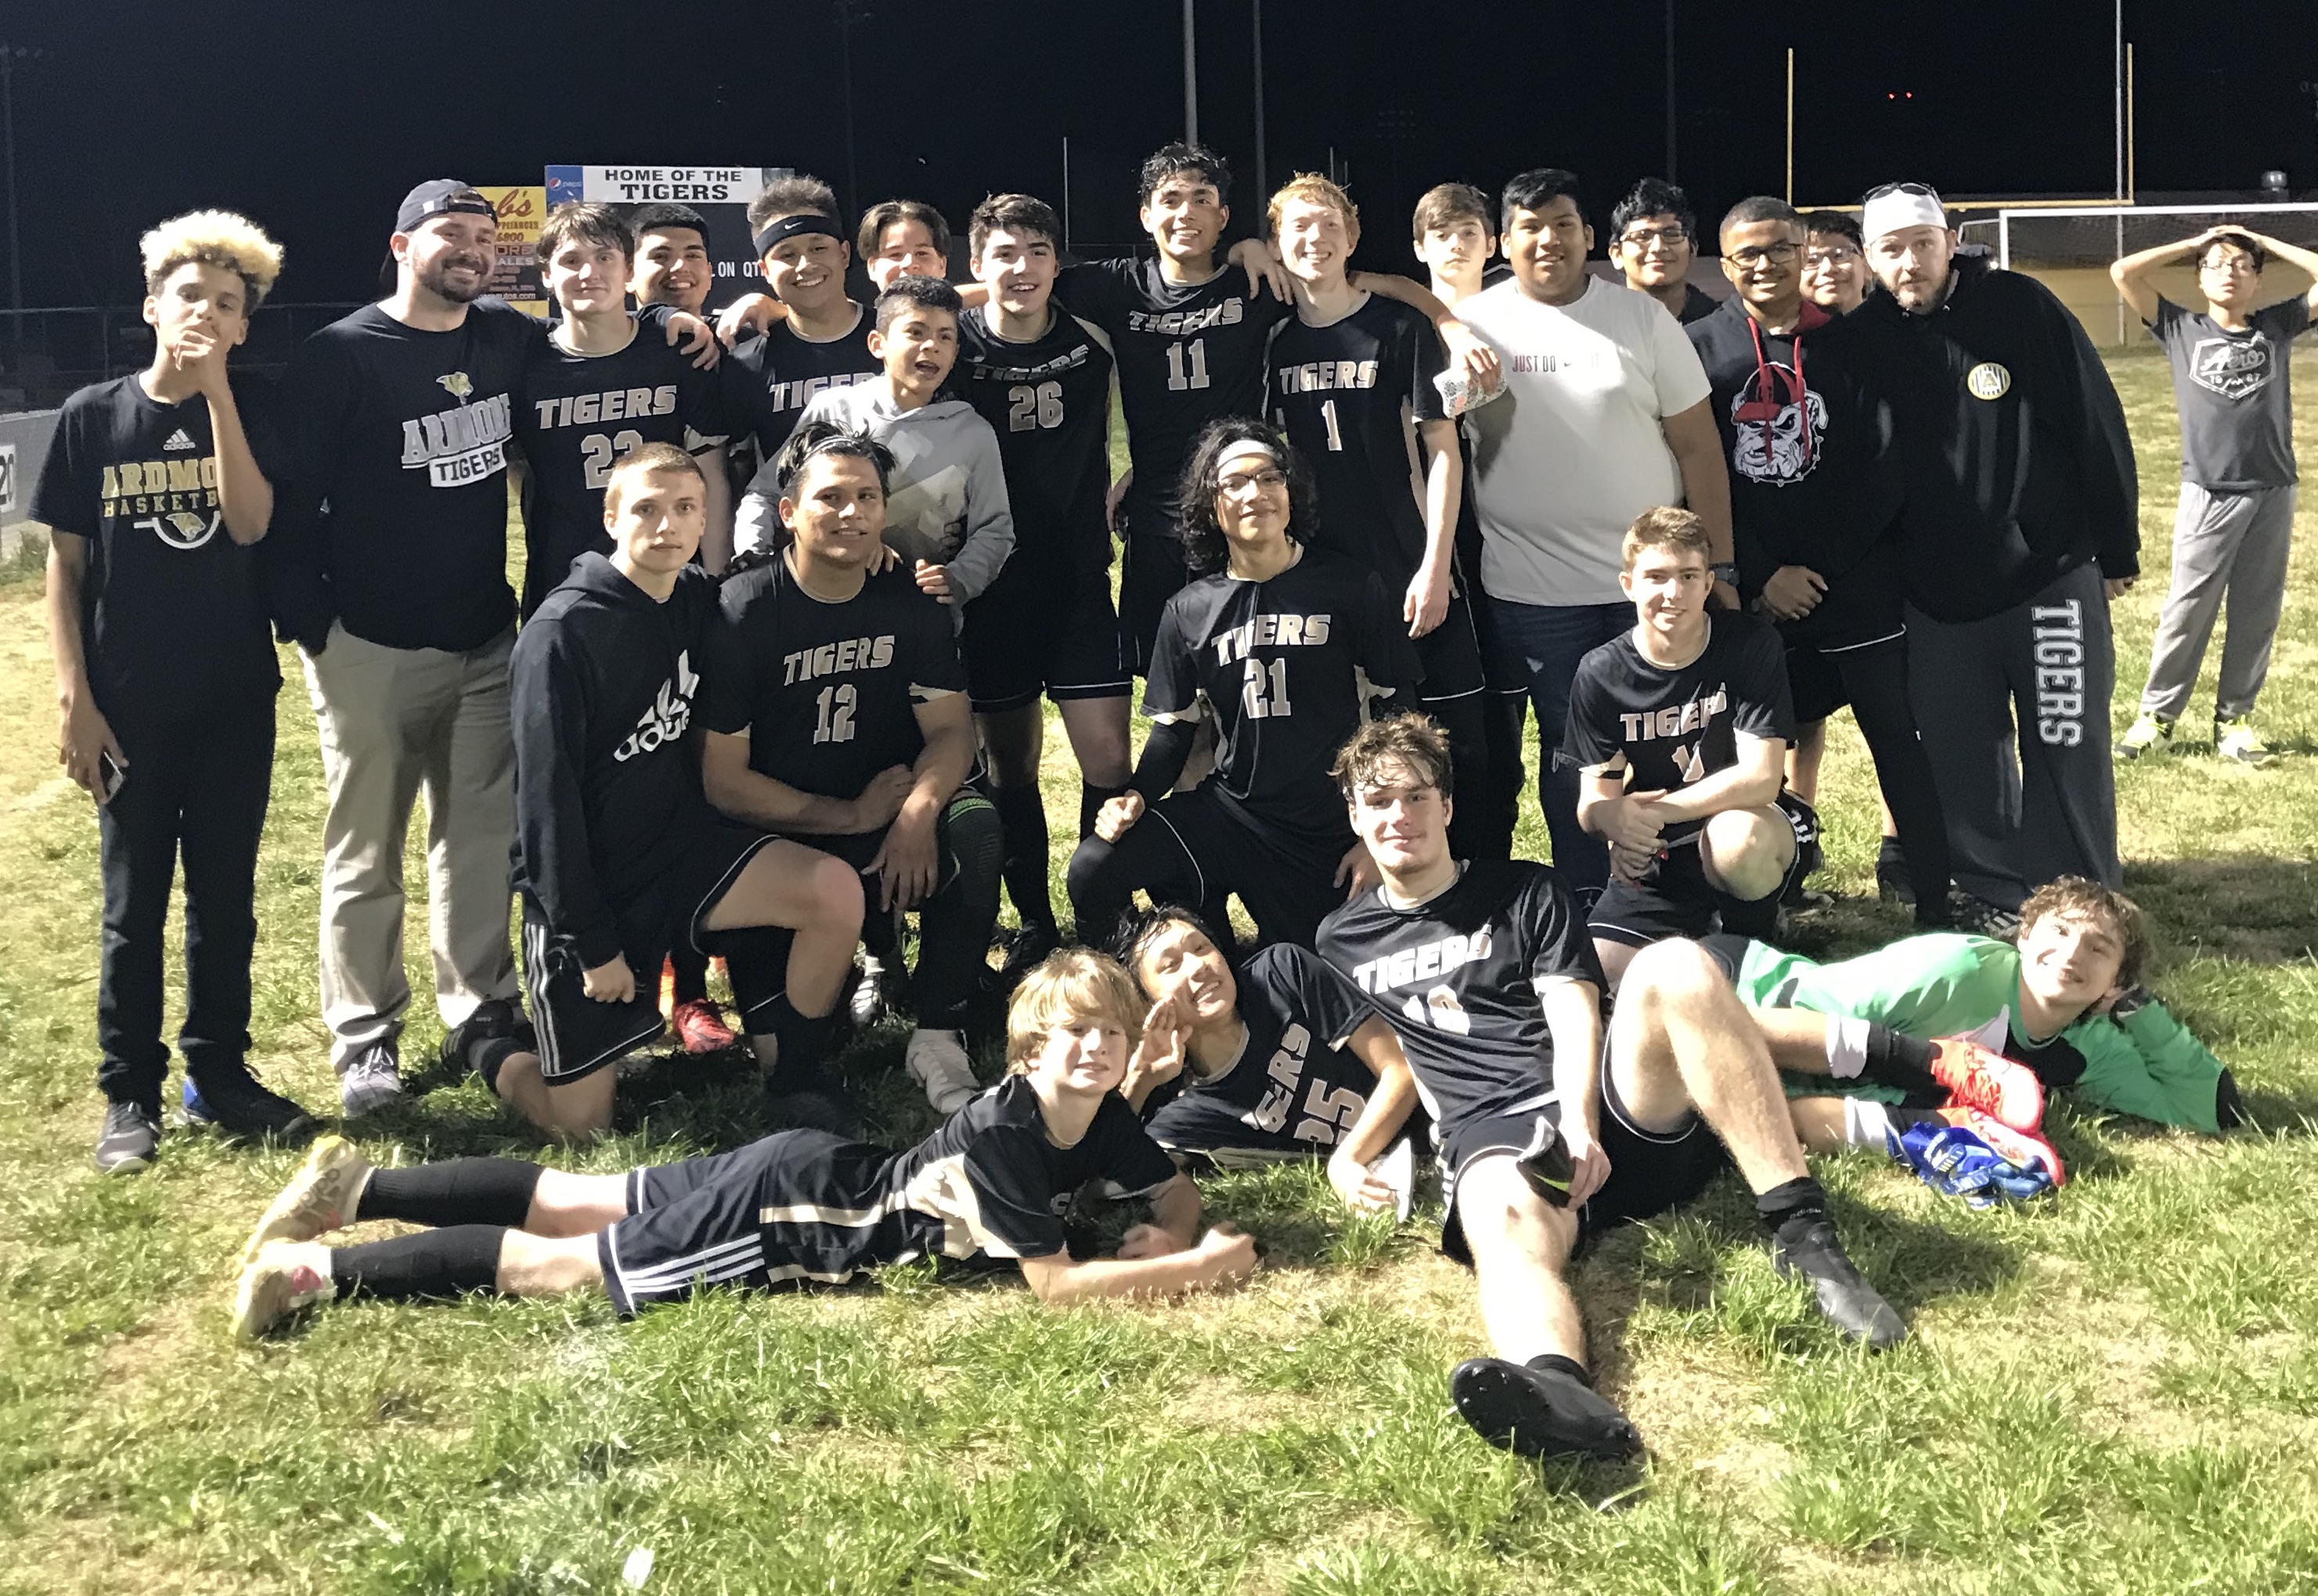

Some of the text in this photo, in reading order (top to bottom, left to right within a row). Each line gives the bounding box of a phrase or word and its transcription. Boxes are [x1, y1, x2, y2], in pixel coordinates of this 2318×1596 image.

[605, 170, 742, 182] HOME OF THE
[620, 184, 729, 200] TIGERS
[491, 189, 534, 218] b's
[718, 261, 735, 278] ON
[1129, 297, 1243, 335] TIGERS
[1166, 338, 1209, 391] 11
[1279, 360, 1379, 394] TIGERS
[1512, 355, 1538, 372] JUST
[1543, 355, 1556, 372] DO
[535, 385, 676, 429] TIGERS
[1009, 380, 1064, 432] 26
[1321, 399, 1343, 452] 1
[435, 447, 499, 481] TIGERS
[783, 635, 895, 686] TIGERS
[2031, 599, 2085, 747] TIGERS
[1242, 657, 1292, 719] 21
[813, 683, 856, 744] 12
[1240, 1023, 1311, 1133] GERS
